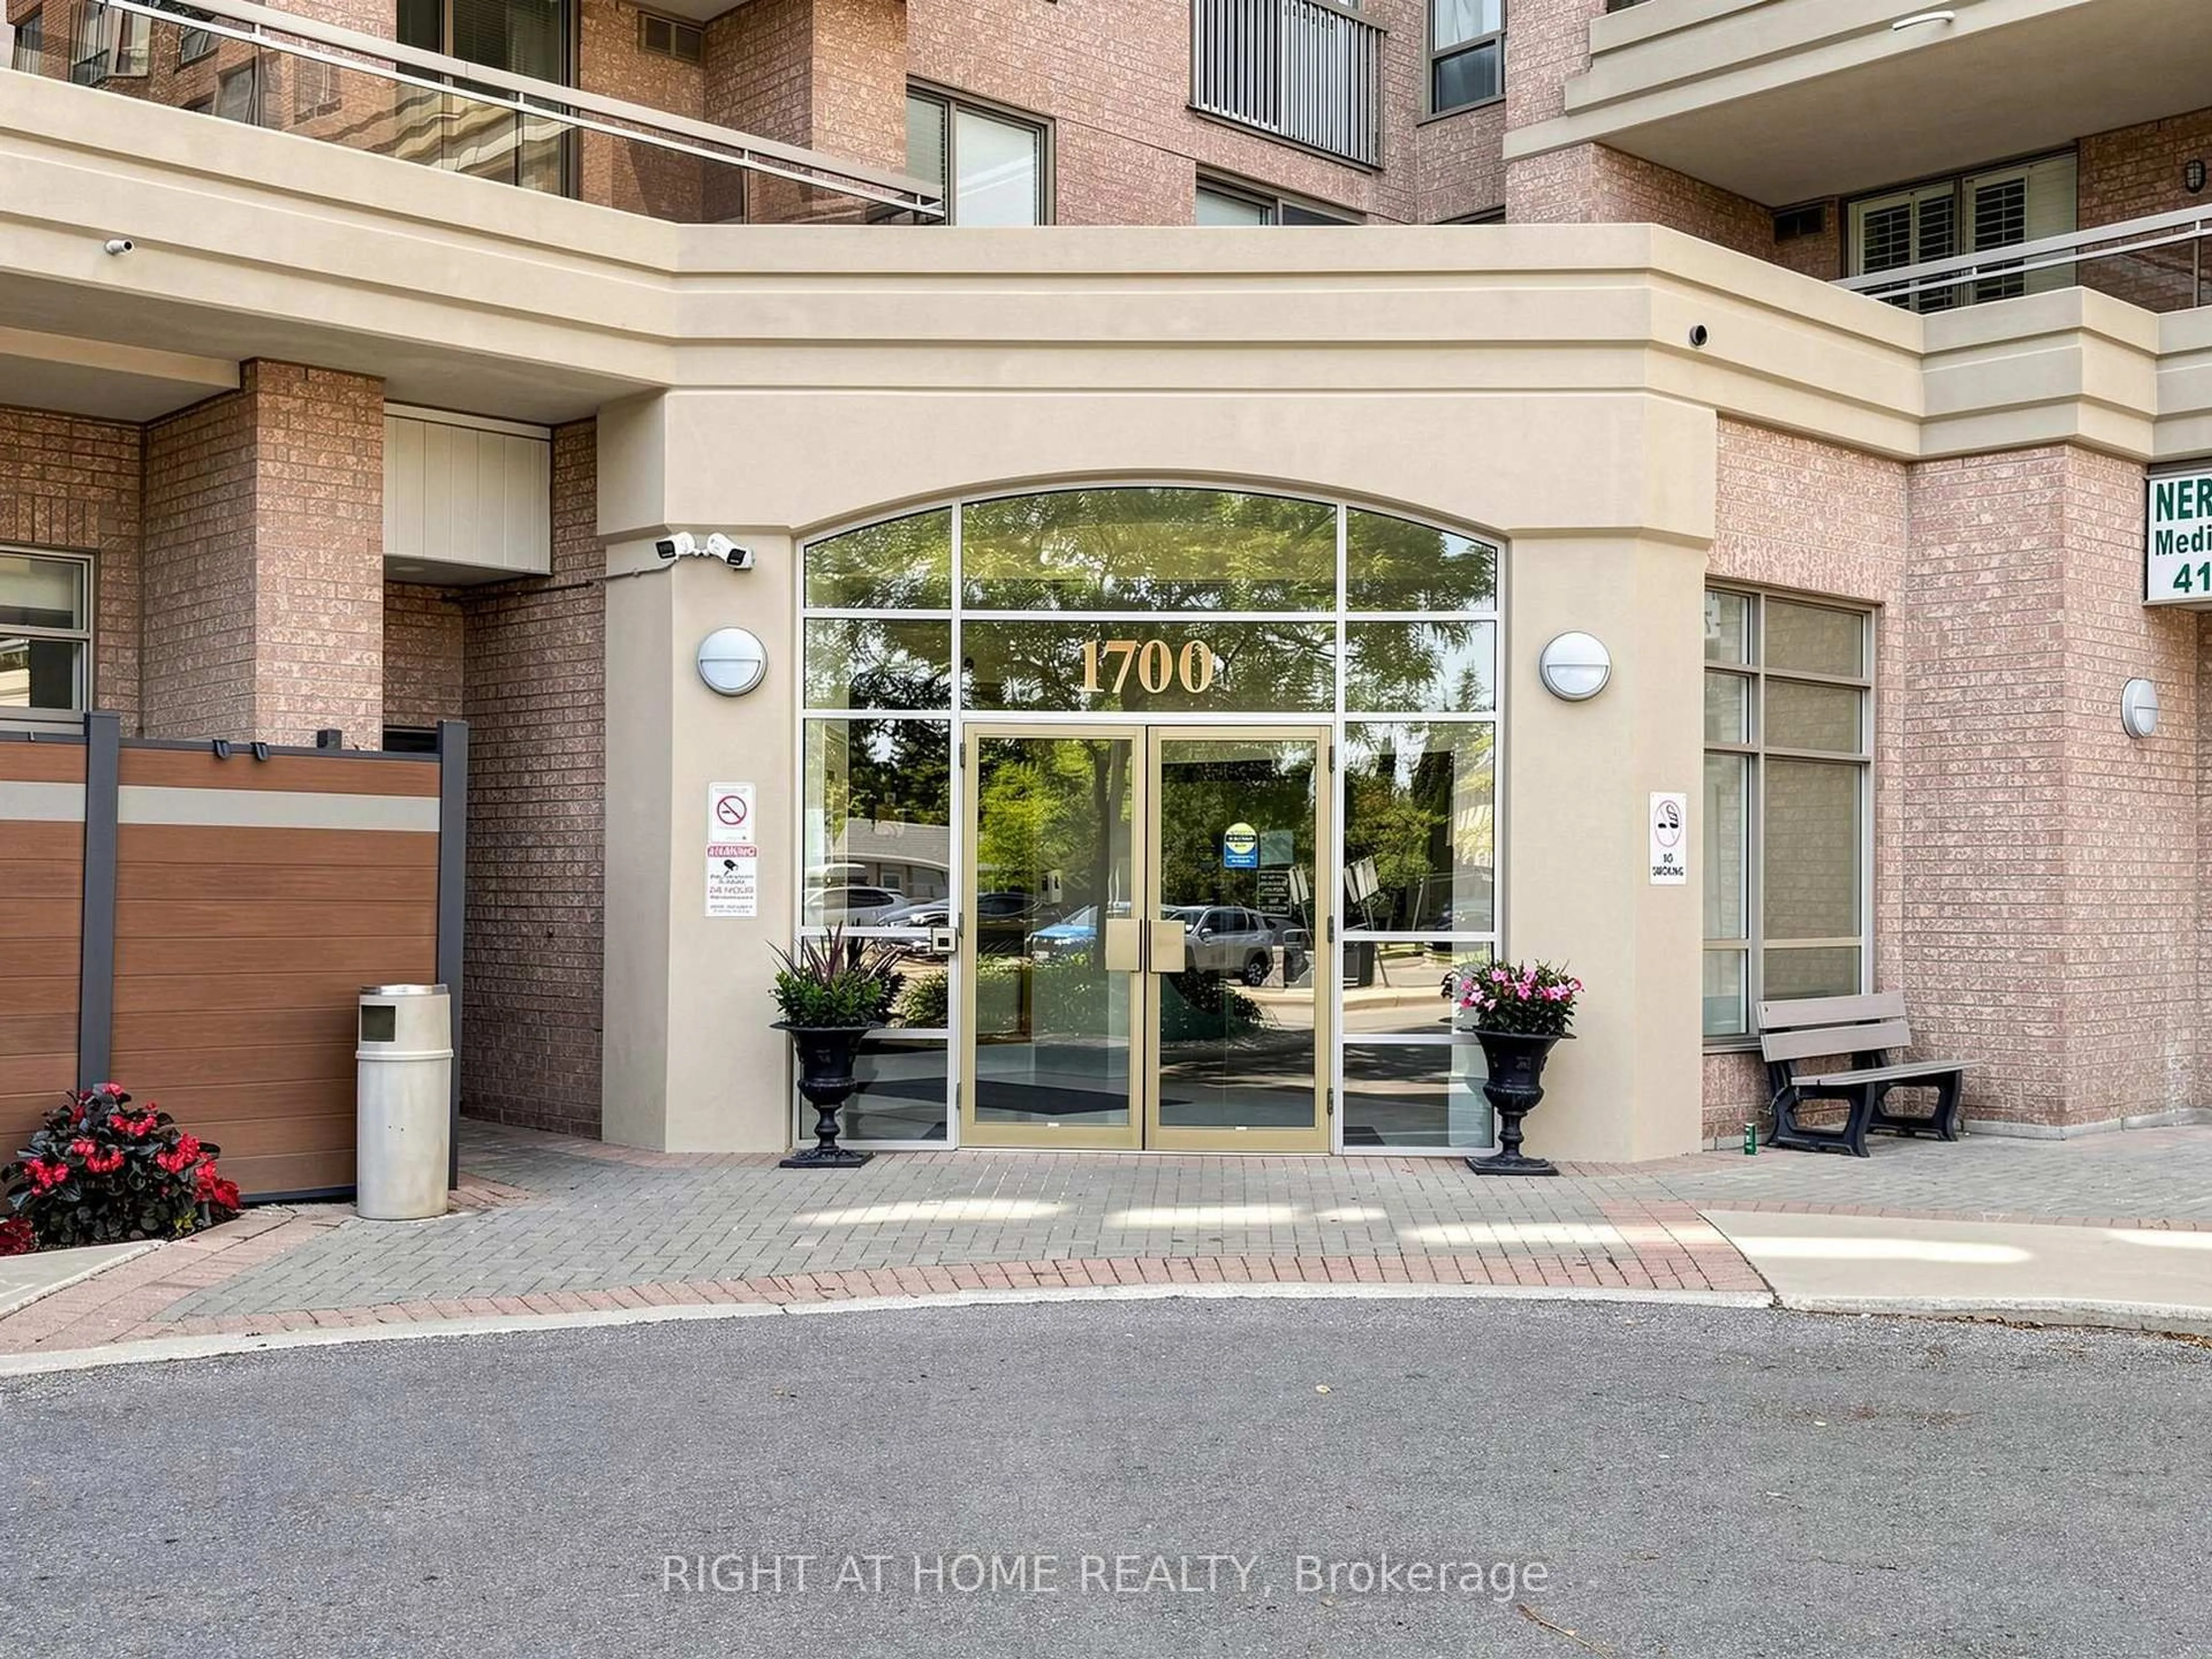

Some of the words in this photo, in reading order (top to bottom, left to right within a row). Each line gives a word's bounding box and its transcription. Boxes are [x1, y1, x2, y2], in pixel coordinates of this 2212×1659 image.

[2156, 478, 2212, 522] NER
[2156, 524, 2212, 556] Medi
[2173, 562, 2211, 593] 41
[1079, 639, 1214, 693] 1700
